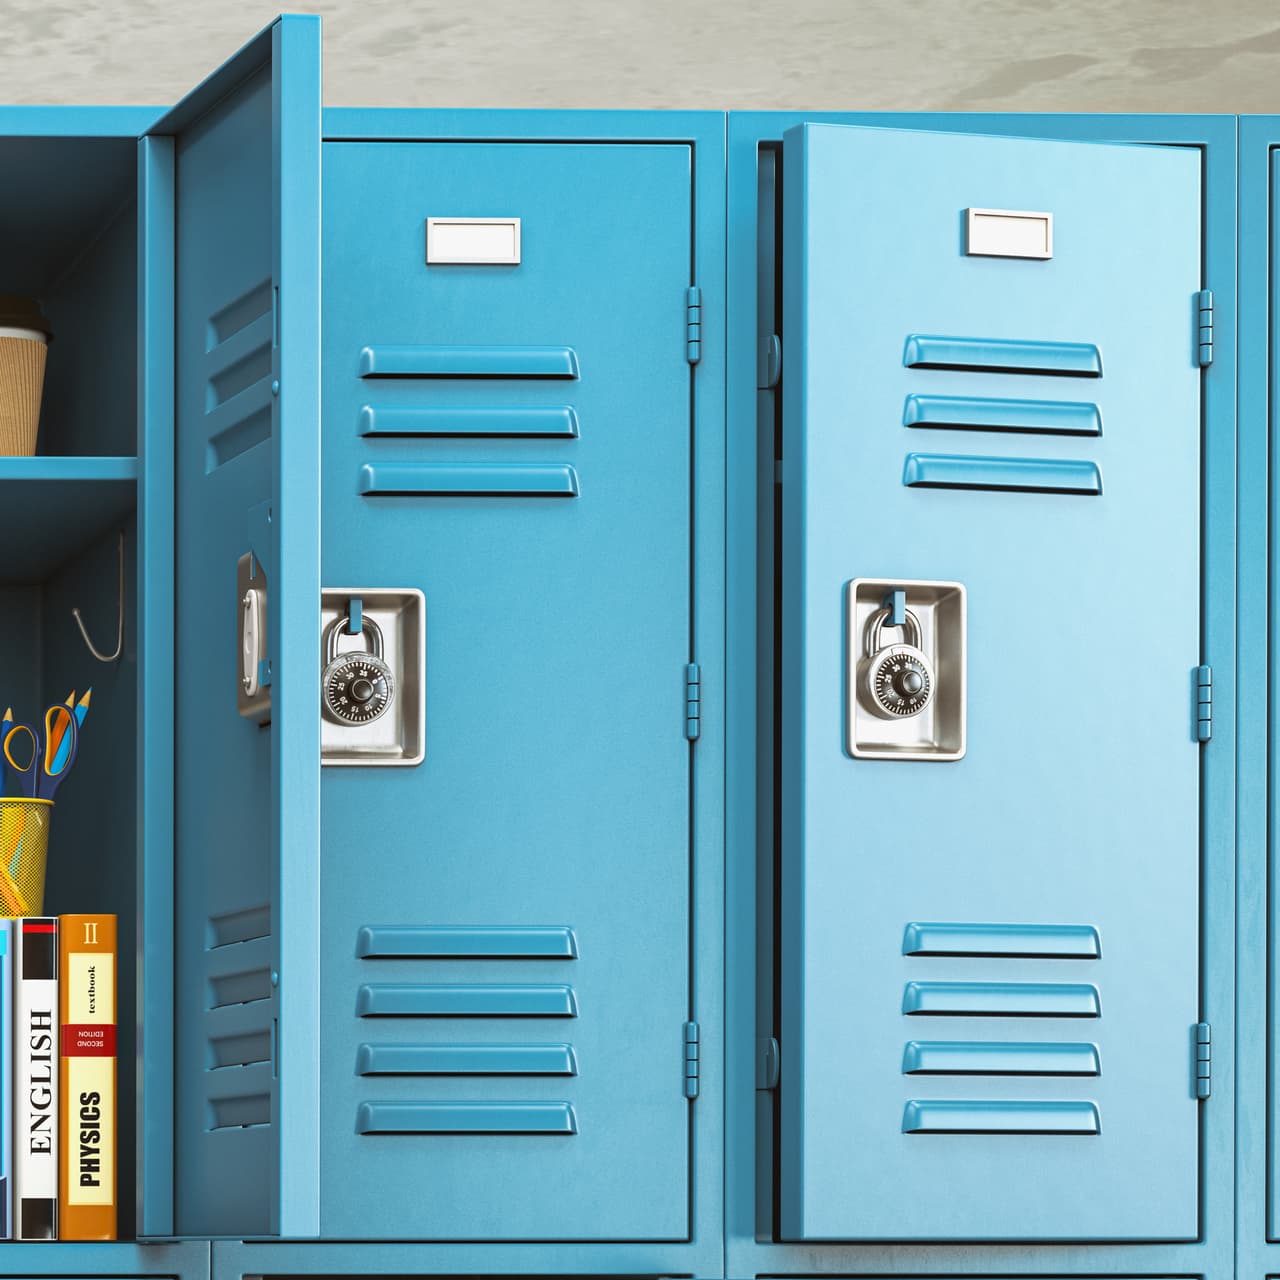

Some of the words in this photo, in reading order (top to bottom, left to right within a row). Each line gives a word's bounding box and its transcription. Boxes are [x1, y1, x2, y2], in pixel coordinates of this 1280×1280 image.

[87, 965, 96, 1014] textbook
[30, 1008, 52, 1156] ENGLISH
[79, 1091, 101, 1187] PHYSICS
